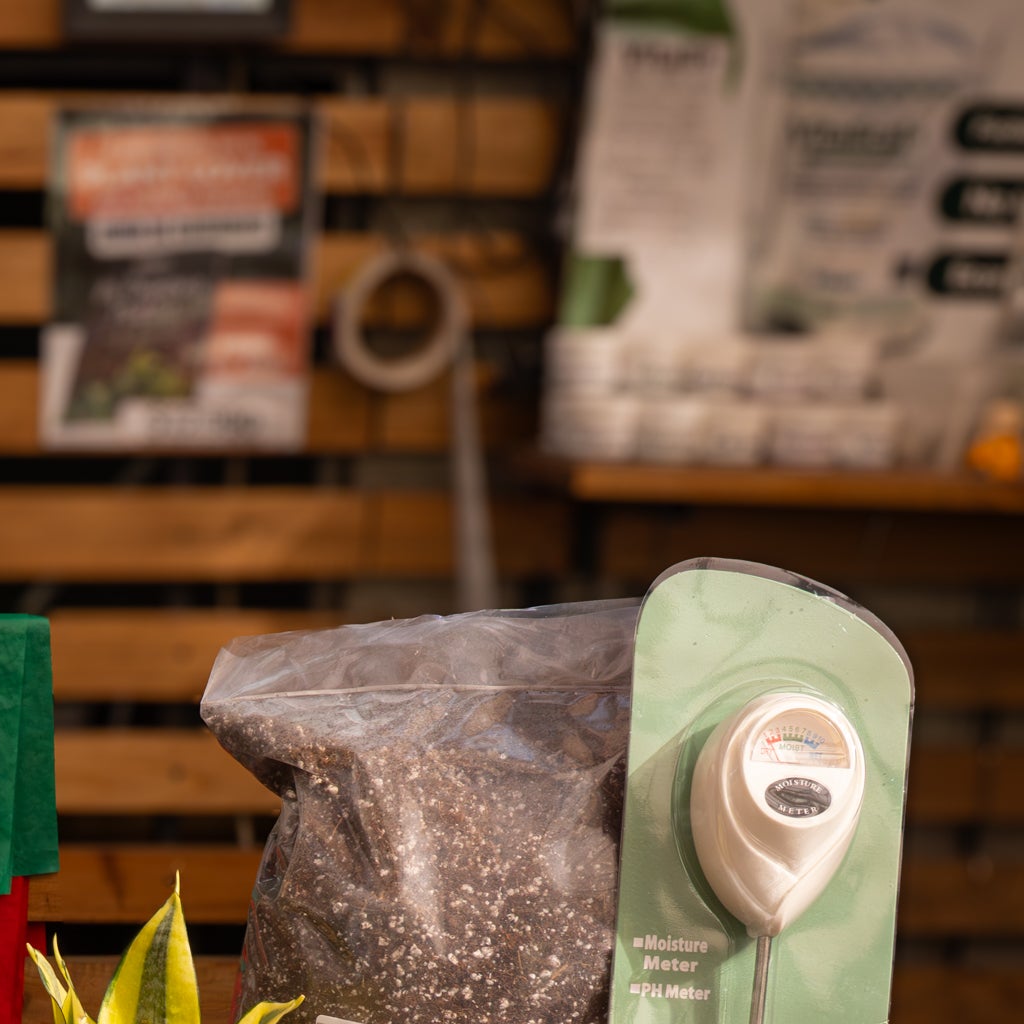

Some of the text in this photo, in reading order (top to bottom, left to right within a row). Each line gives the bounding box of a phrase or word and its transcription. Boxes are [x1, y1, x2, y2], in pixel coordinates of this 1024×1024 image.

[774, 779, 823, 794] MOISTURE
[778, 804, 818, 815] METER
[644, 934, 708, 953] Moisture
[643, 955, 698, 972] Meter
[641, 982, 711, 1000] PH Meter
